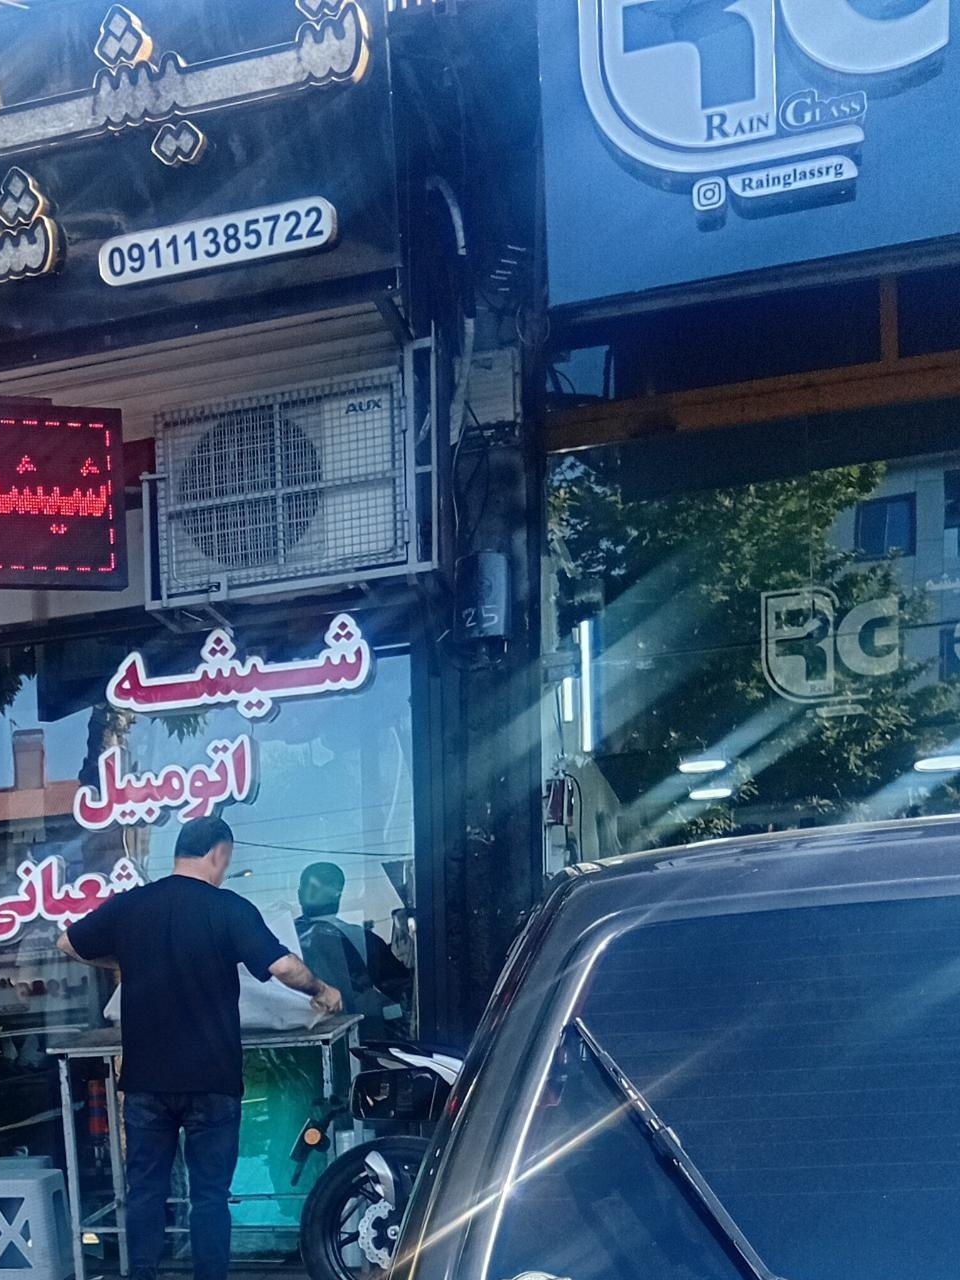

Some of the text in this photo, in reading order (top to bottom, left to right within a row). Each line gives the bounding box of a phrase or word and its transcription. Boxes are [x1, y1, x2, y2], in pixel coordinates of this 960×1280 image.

[740, 160, 844, 194] Rainglassrg
[107, 205, 327, 279] 09111385722
[345, 398, 382, 414] AUX
[461, 604, 499, 628] 25
[108, 612, 373, 720] شیشه
[73, 734, 256, 830] اتومبیل
